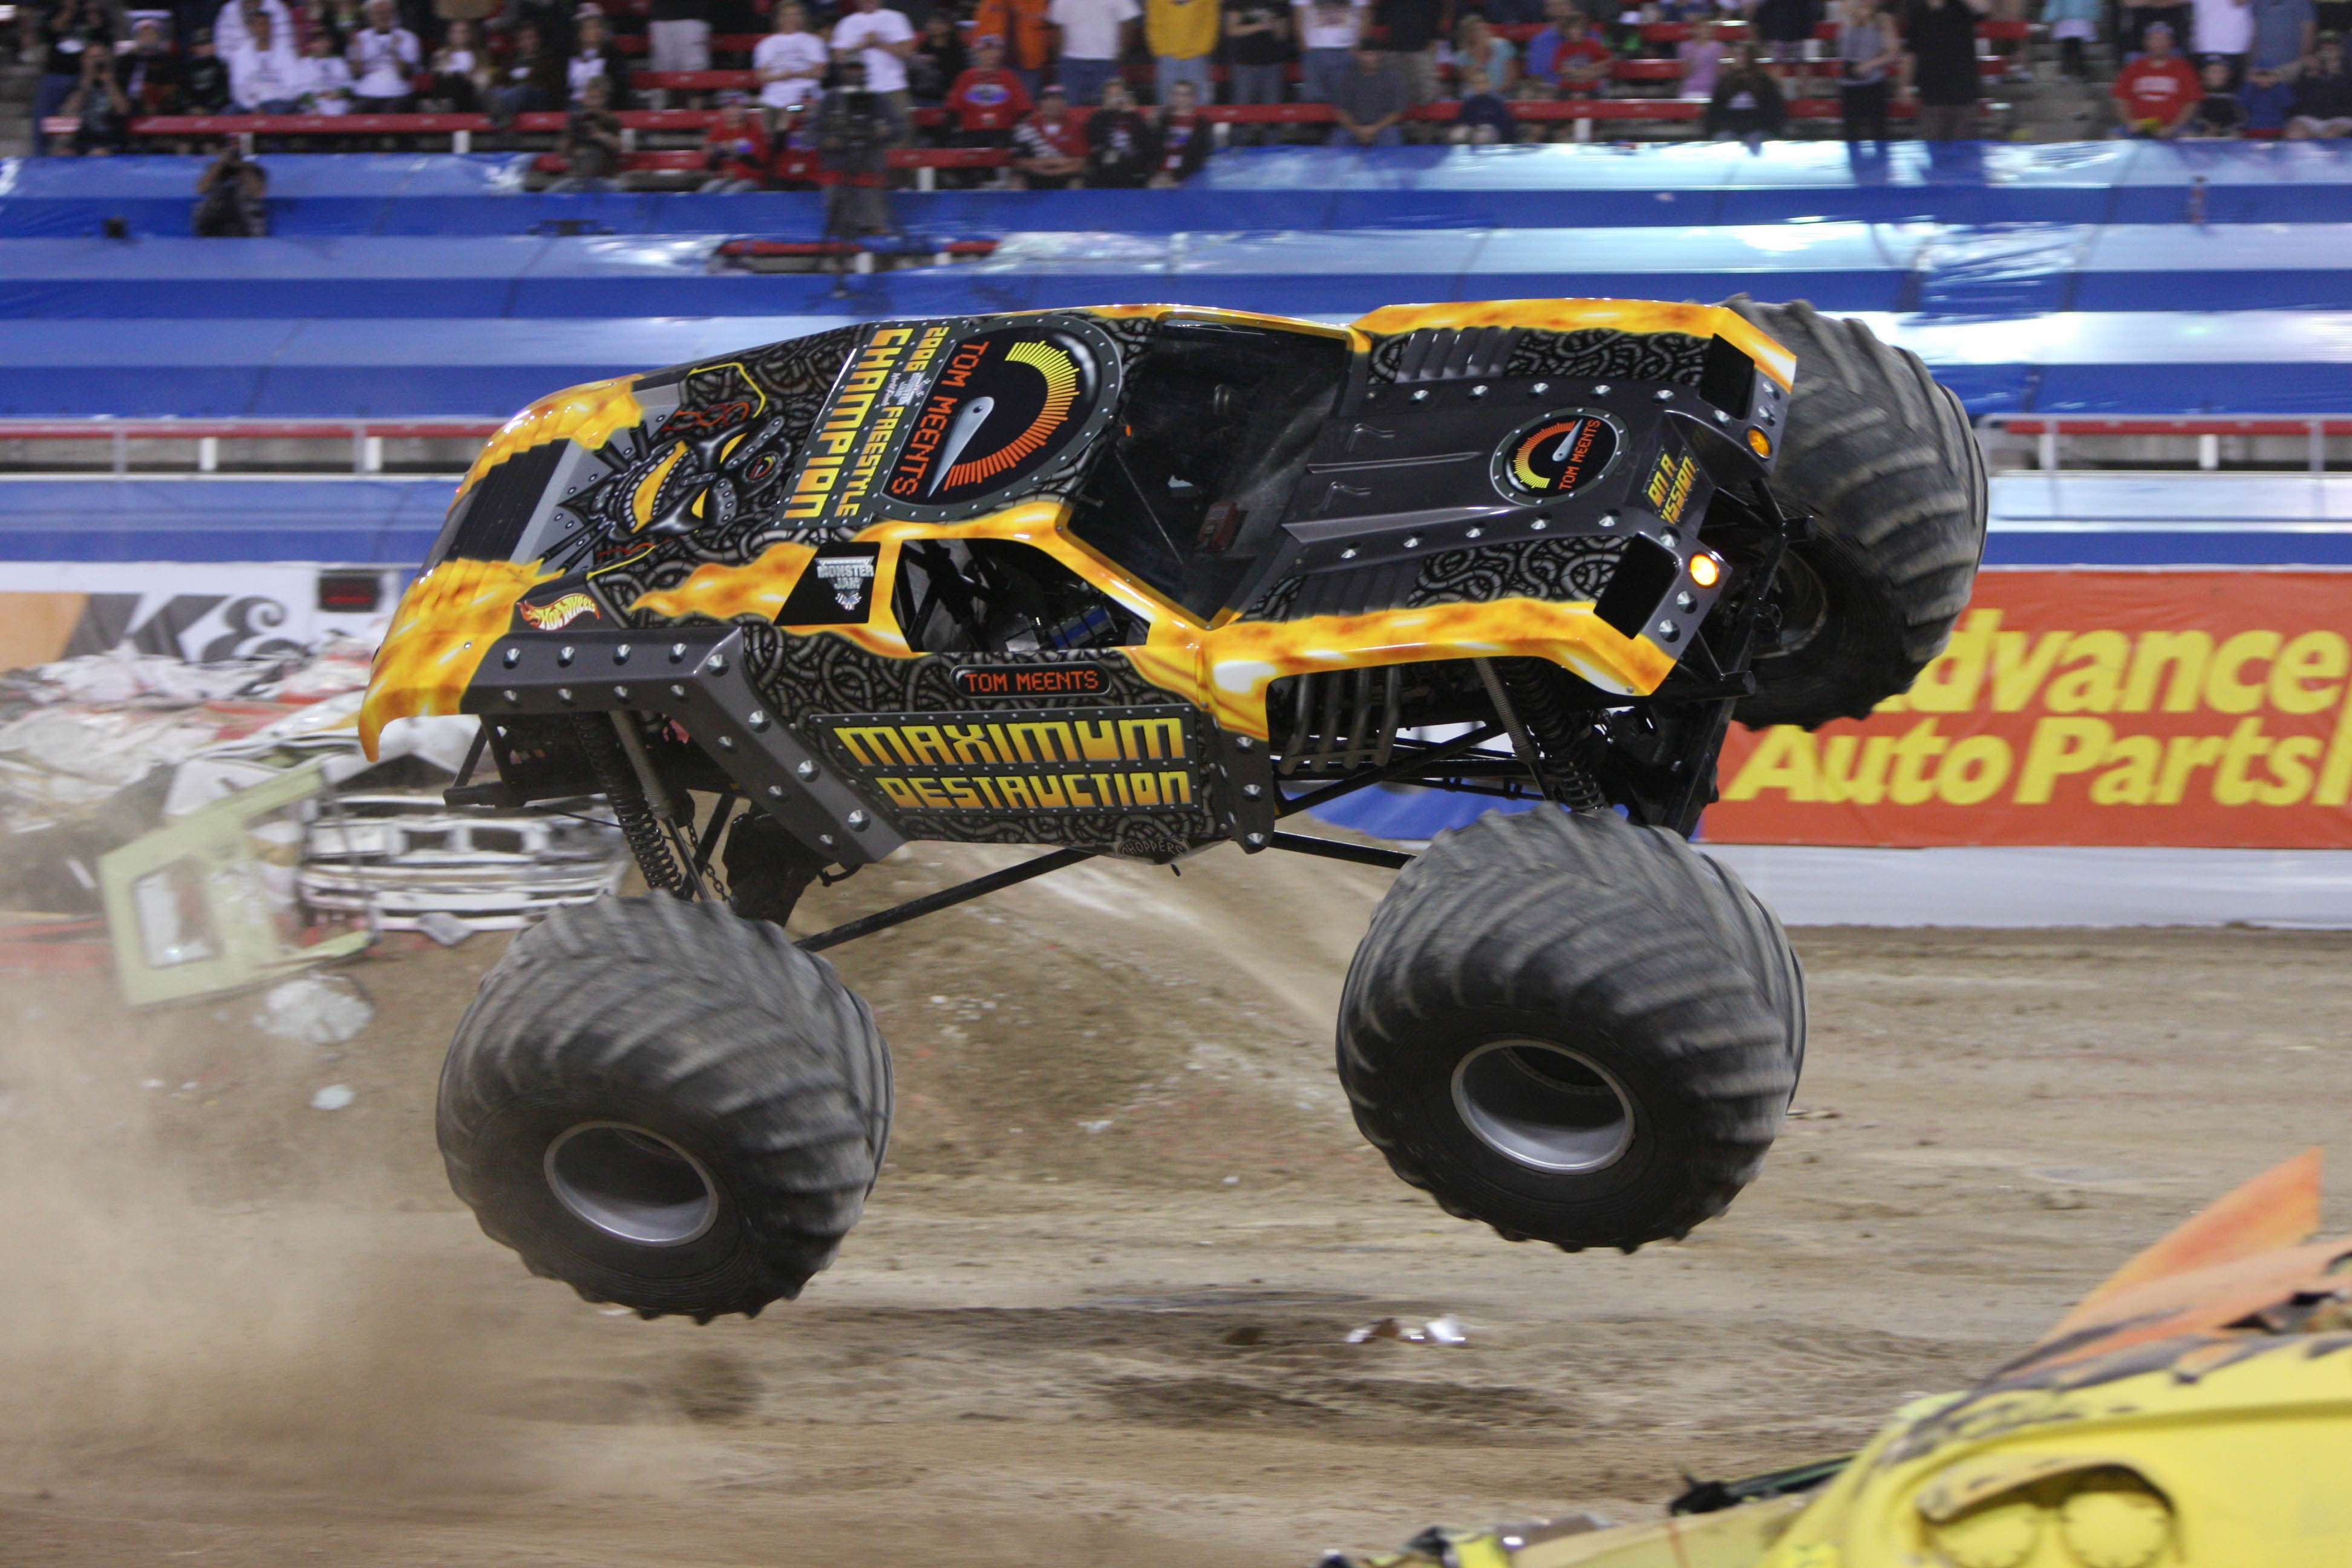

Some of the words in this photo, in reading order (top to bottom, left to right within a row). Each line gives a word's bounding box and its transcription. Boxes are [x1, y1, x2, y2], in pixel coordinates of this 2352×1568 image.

[903, 326, 950, 372] 2006
[941, 341, 990, 387] TOM
[783, 328, 914, 518] CHAMPION
[891, 396, 959, 495] MEENTS
[834, 407, 905, 517] FREESTYLE
[1558, 466, 1581, 490] TOM
[1570, 419, 1601, 462] MEENTS
[1660, 454, 1677, 477] A
[1660, 456, 1696, 524] ISSION
[817, 564, 875, 578] MONSTER
[965, 673, 1008, 692] TOM
[1016, 670, 1099, 691] MEENTS
[1872, 608, 2348, 713] dvance
[833, 717, 1186, 766] MAXIMUM
[1720, 717, 2014, 806] Auto
[2013, 716, 2325, 806] Parts
[875, 771, 1192, 809] DESTRUCTION
